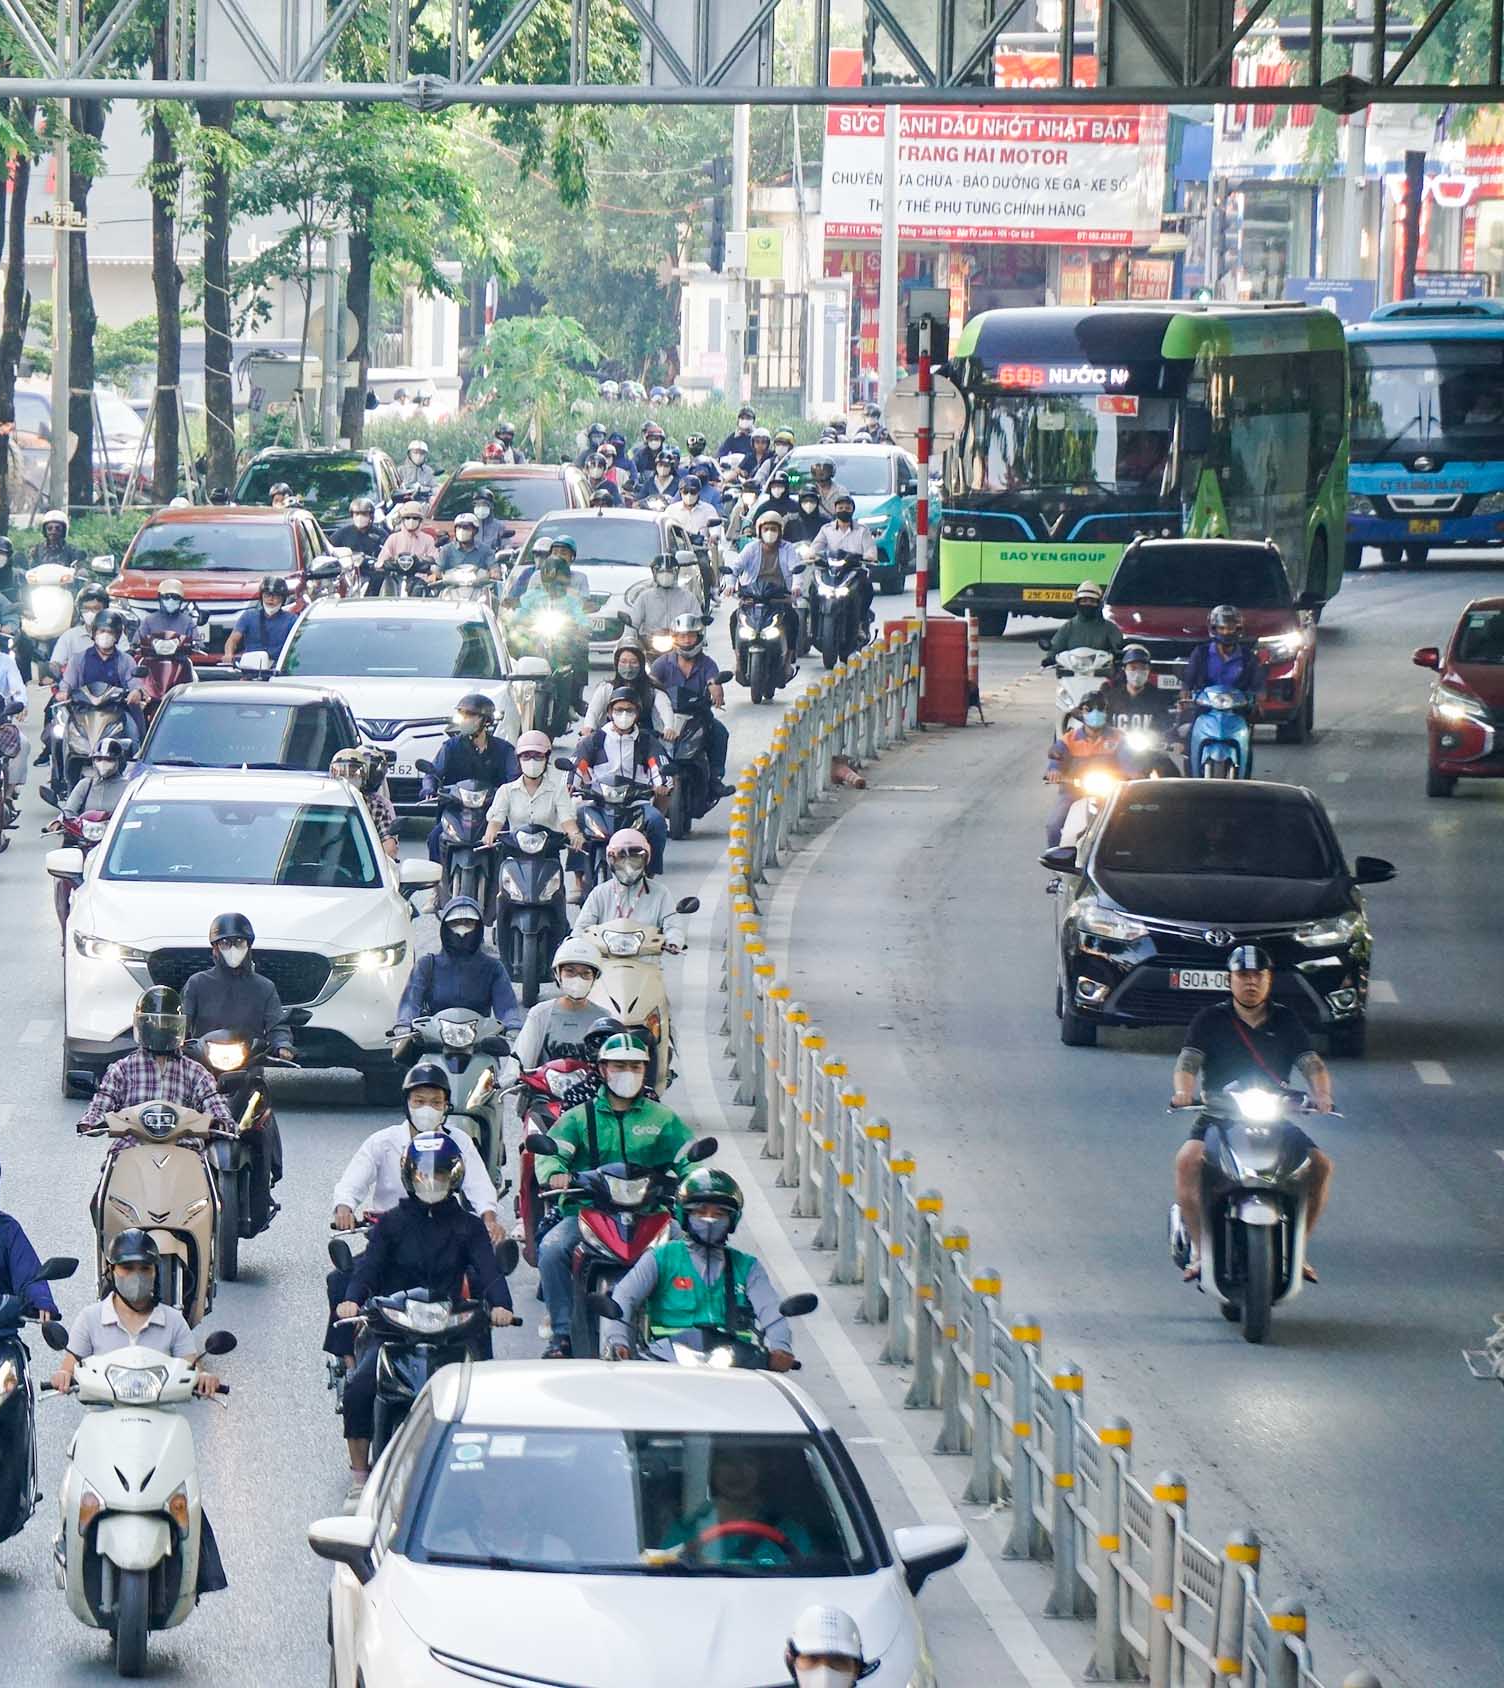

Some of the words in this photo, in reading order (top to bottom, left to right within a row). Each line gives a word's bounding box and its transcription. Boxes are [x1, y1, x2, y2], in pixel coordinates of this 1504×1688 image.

[839, 112, 880, 133] SỨC
[882, 115, 937, 137] ẠNH
[982, 115, 1036, 137] NHỚT
[1038, 116, 1089, 141] NHẬT
[1000, 148, 1068, 165] MOTOR
[1044, 178, 1059, 190] XE
[1063, 178, 1081, 190] GA
[1090, 179, 1107, 192] XE
[1110, 174, 1129, 192] SỐ
[934, 200, 962, 217] PHỤ
[999, 365, 1045, 387] 60B
[1049, 364, 1107, 385] NƯỚC
[1030, 551, 1058, 561] YEN
[1060, 552, 1106, 562] GROUP
